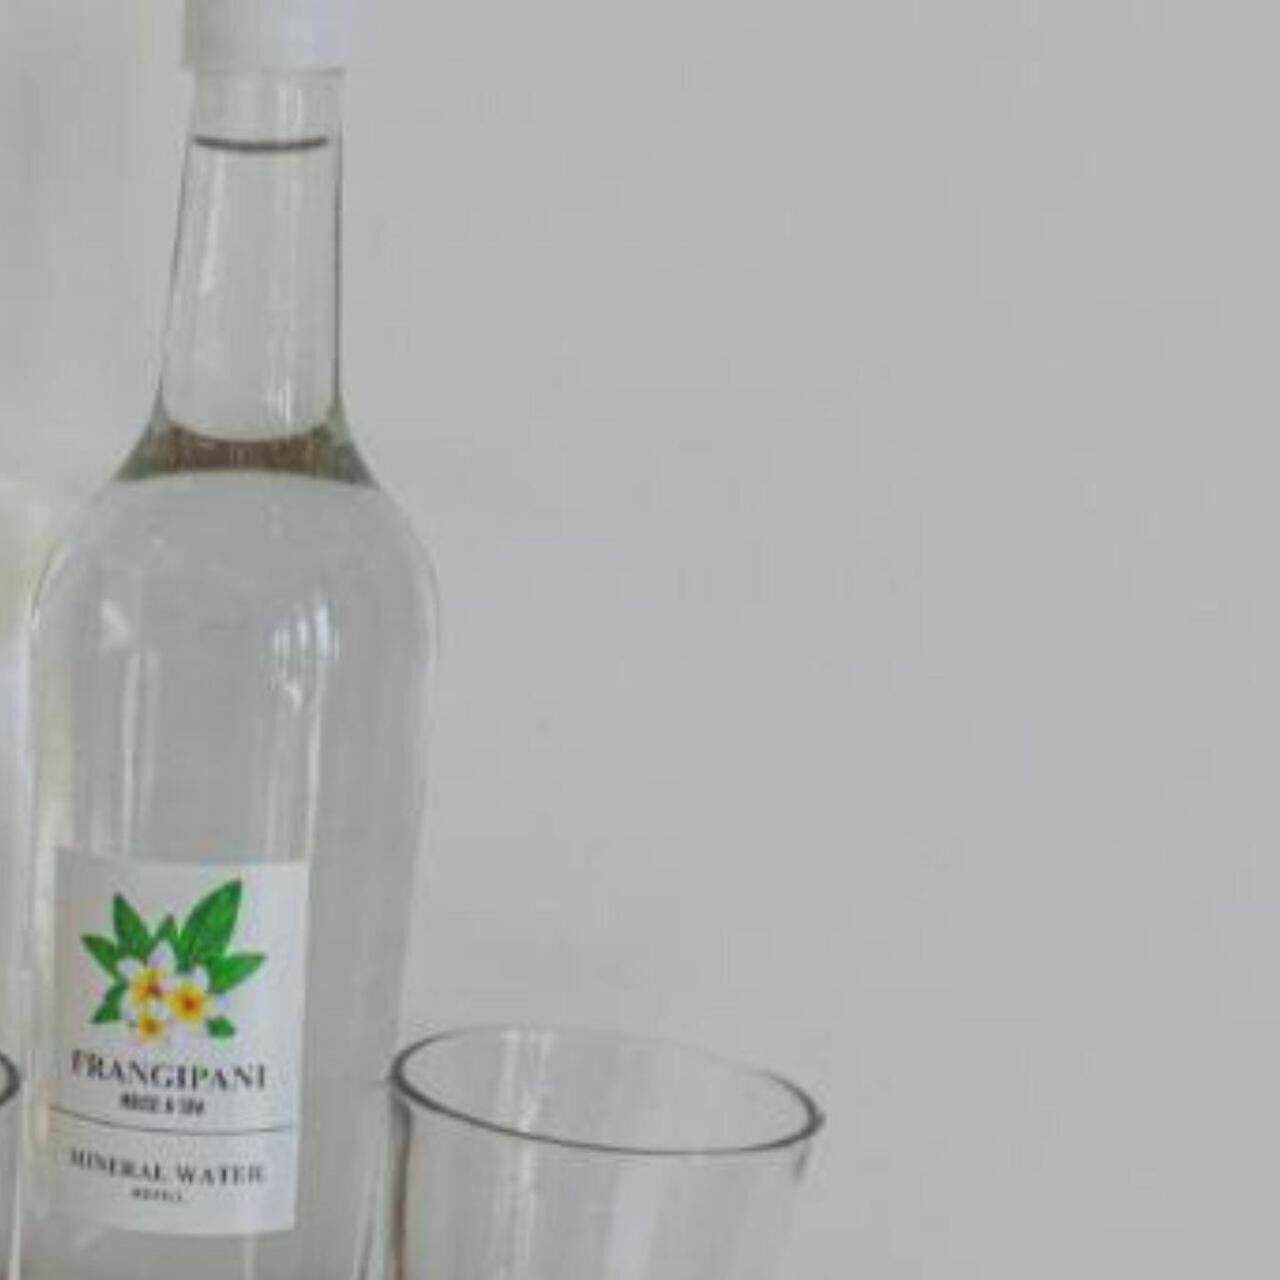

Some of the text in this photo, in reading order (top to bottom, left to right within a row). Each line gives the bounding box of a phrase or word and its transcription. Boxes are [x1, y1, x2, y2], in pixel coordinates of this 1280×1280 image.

[70, 1049, 266, 1091] FRANGIPANI
[69, 1147, 264, 1186] MINERAL WATER
